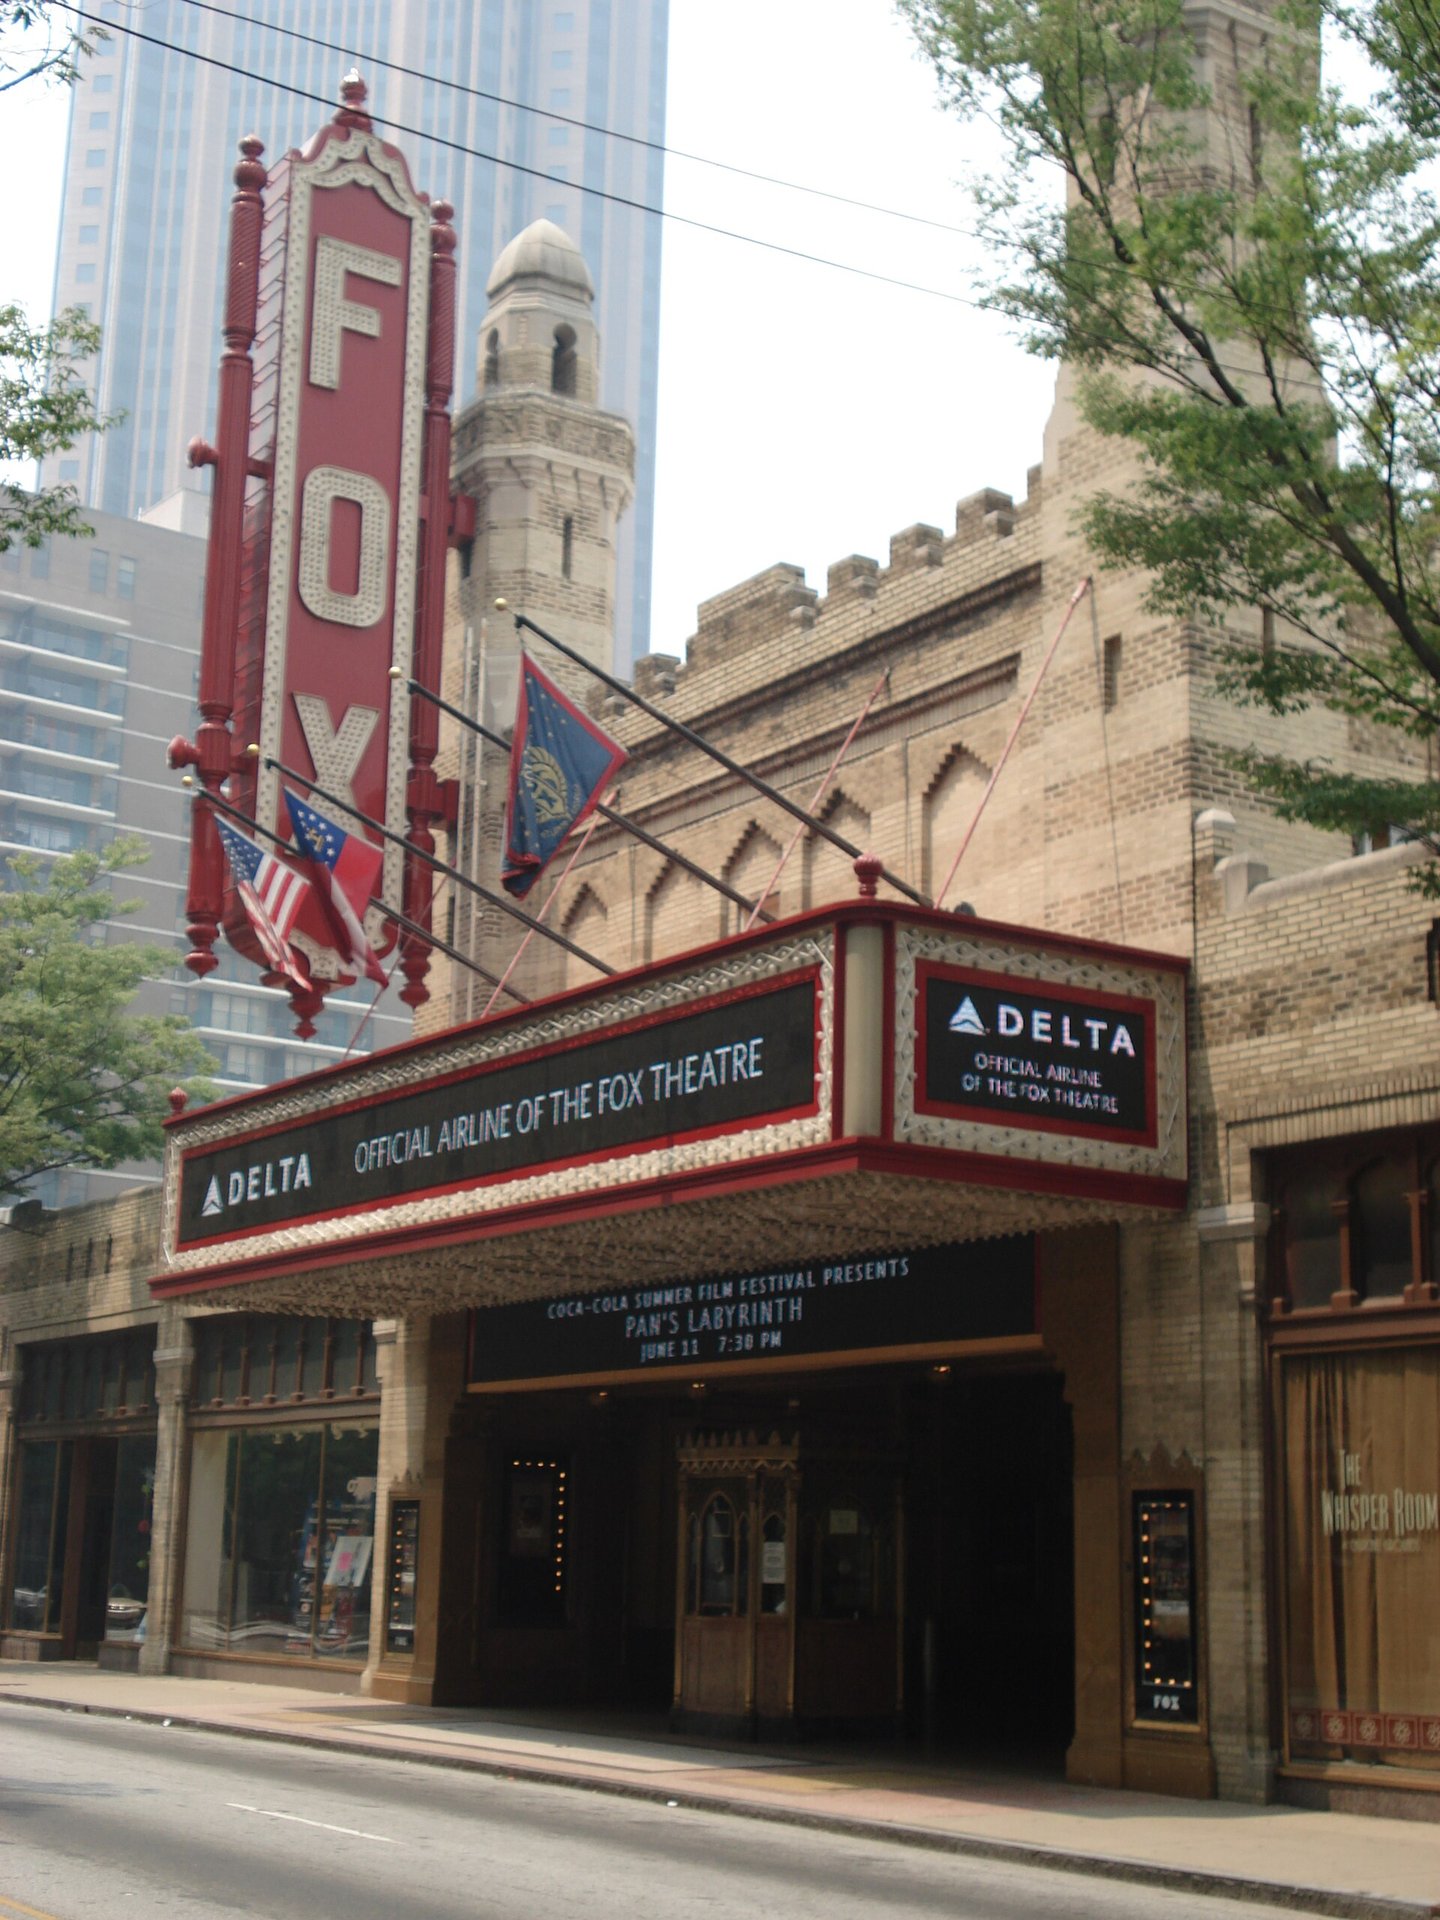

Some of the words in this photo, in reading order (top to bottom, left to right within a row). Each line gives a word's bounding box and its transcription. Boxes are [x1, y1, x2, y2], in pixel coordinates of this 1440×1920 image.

[283, 234, 402, 858] FOX
[997, 1003, 1136, 1058] DELTA
[961, 1073, 982, 1092] OF
[988, 1077, 1017, 1099] THE
[1019, 1082, 1051, 1103] FOX
[1053, 1086, 1119, 1114] THEATRE
[974, 1052, 1042, 1079] OFFICIAL
[1047, 1063, 1102, 1089] AIRLINE
[354, 1125, 433, 1174] OFFICIAL
[437, 1103, 513, 1153] AIRLINE
[515, 1094, 546, 1135] OF
[549, 1082, 593, 1126] THE
[598, 1068, 644, 1115] FOX
[649, 1037, 764, 1101] THEATRE
[227, 1152, 312, 1206] DELTA
[547, 1295, 628, 1320] COCA-COLA
[634, 1286, 693, 1309] SUMMER
[698, 1280, 734, 1300] FILM
[738, 1270, 816, 1297] FESTIVAL
[822, 1256, 910, 1286] PRESENTS
[625, 1310, 680, 1339] PAN'S
[687, 1296, 803, 1333] LABYRINTH
[640, 1340, 676, 1363] JUNE
[681, 1337, 699, 1356] 11
[717, 1333, 754, 1353] 7:30
[759, 1329, 783, 1349] PM
[1339, 1449, 1361, 1490] THE
[1320, 1489, 1389, 1537] WHISPER
[1393, 1487, 1439, 1537] ROOM
[1152, 1694, 1180, 1712] FOX
